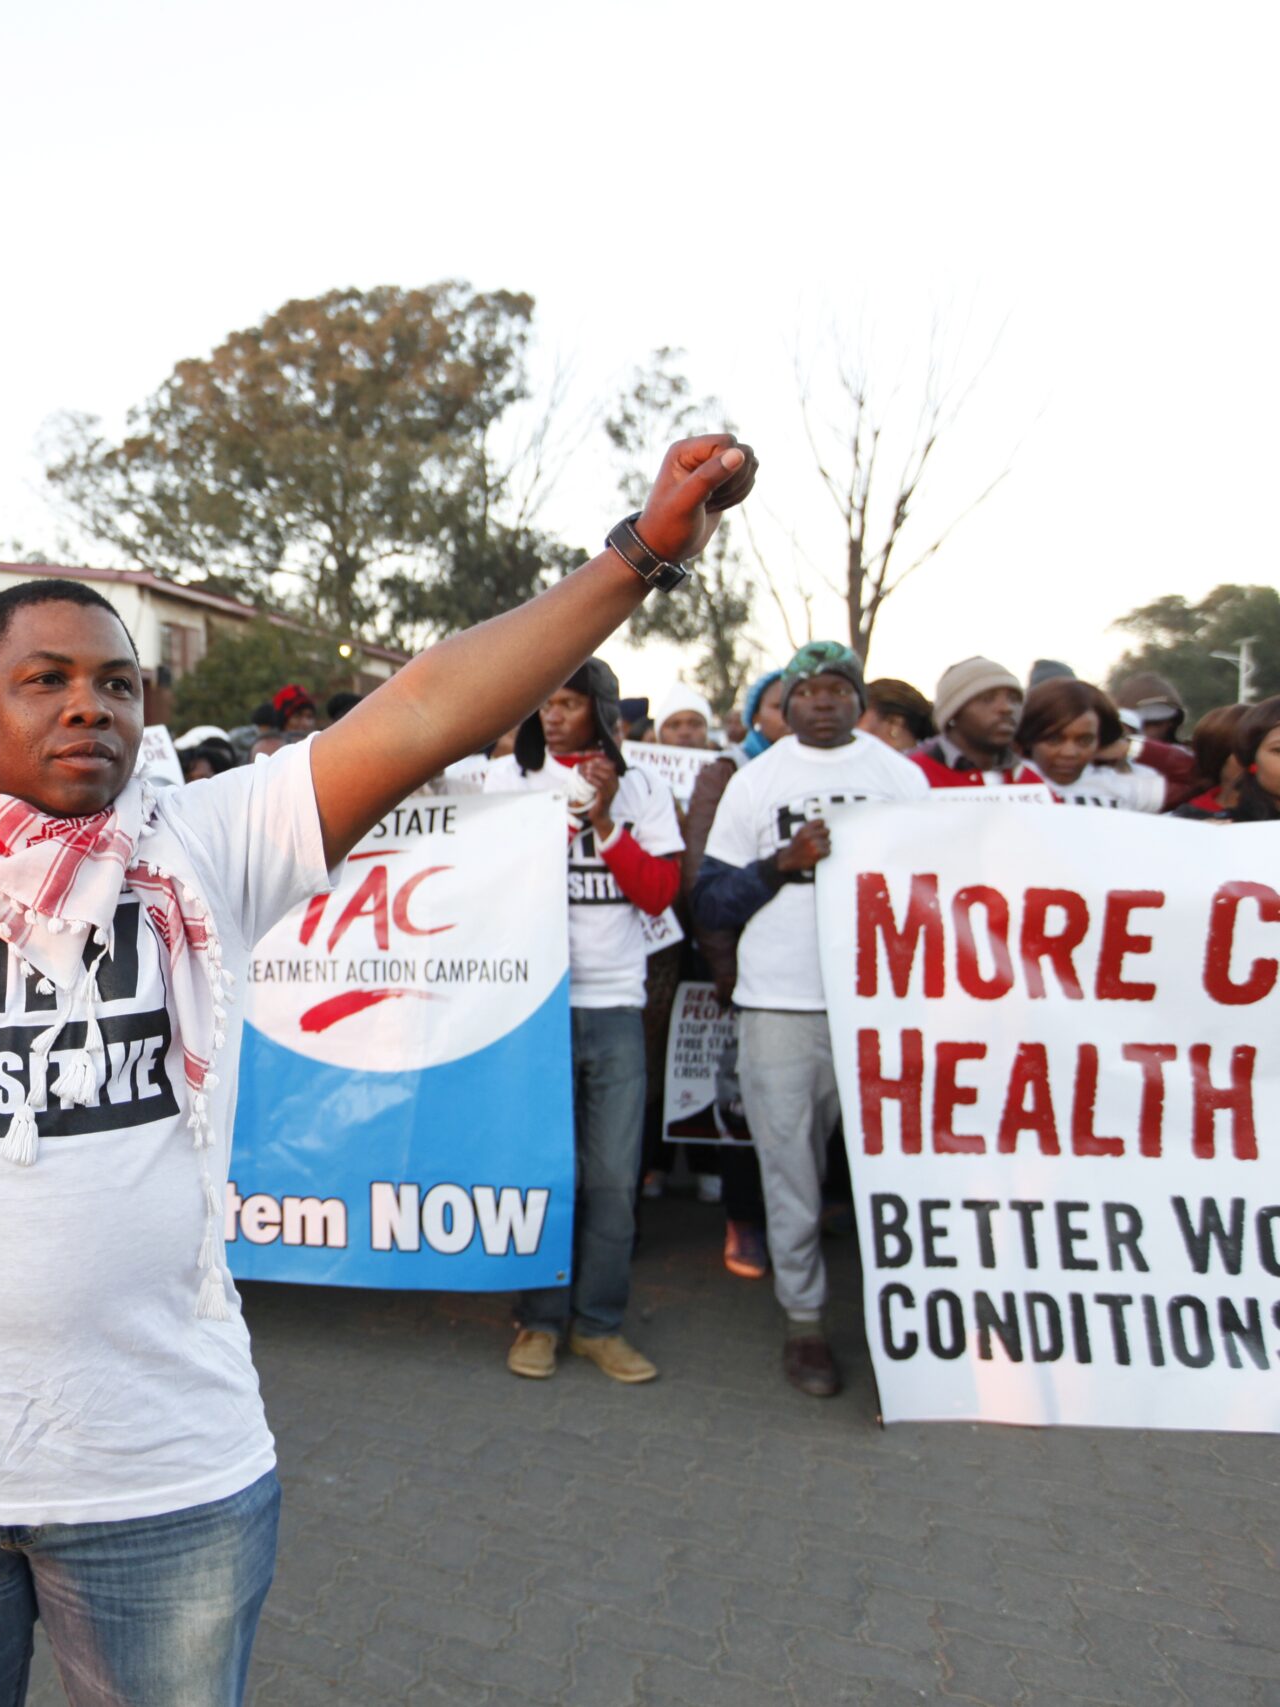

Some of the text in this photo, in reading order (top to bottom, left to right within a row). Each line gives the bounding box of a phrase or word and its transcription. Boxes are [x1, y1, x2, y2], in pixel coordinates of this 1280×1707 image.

[247, 957, 529, 983] EATMENT ACTION CAMPAIGN
[855, 871, 1166, 1001] MORE
[857, 1028, 1258, 1161] HEALTH
[369, 1181, 551, 1256] NOW
[870, 1193, 1150, 1273] BETTER
[879, 1282, 1280, 1370] CONDITION
